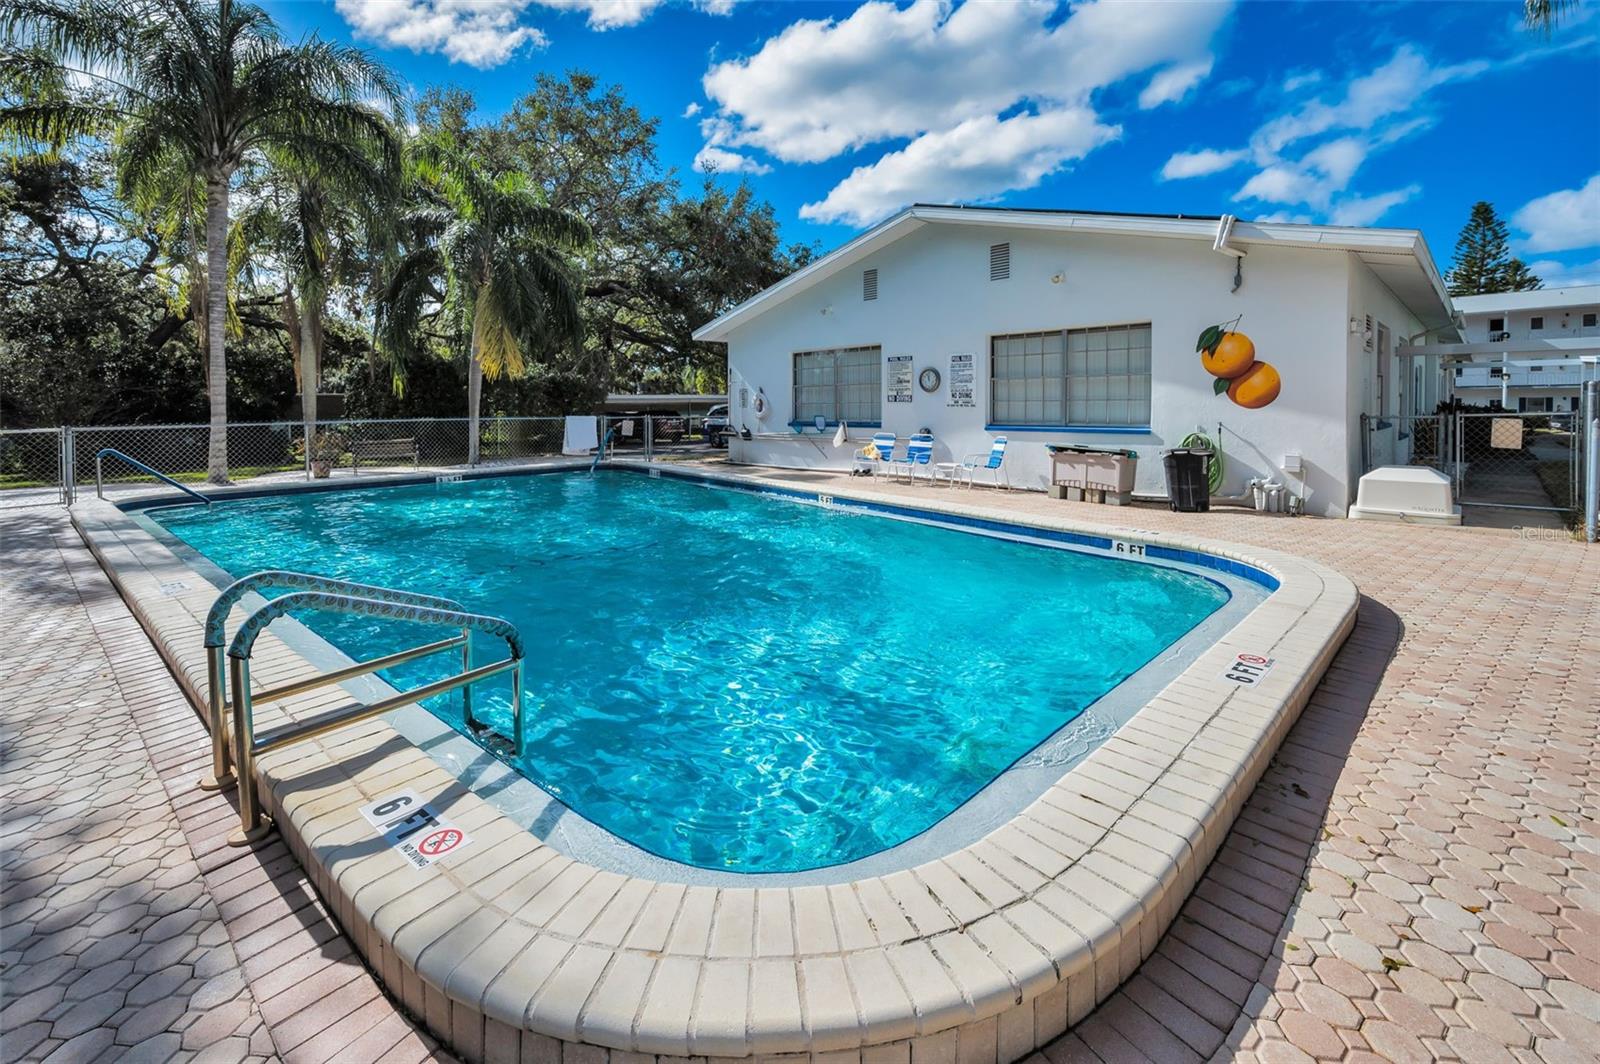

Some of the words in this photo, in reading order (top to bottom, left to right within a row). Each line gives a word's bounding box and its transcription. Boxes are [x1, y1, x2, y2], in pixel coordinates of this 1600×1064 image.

[1129, 544, 1144, 556] FT
[1231, 661, 1264, 677] FT
[1225, 673, 1254, 684] 6
[373, 796, 413, 817] 6
[385, 808, 441, 840] FT
[401, 843, 414, 853] NO
[407, 848, 430, 867] DIVING
